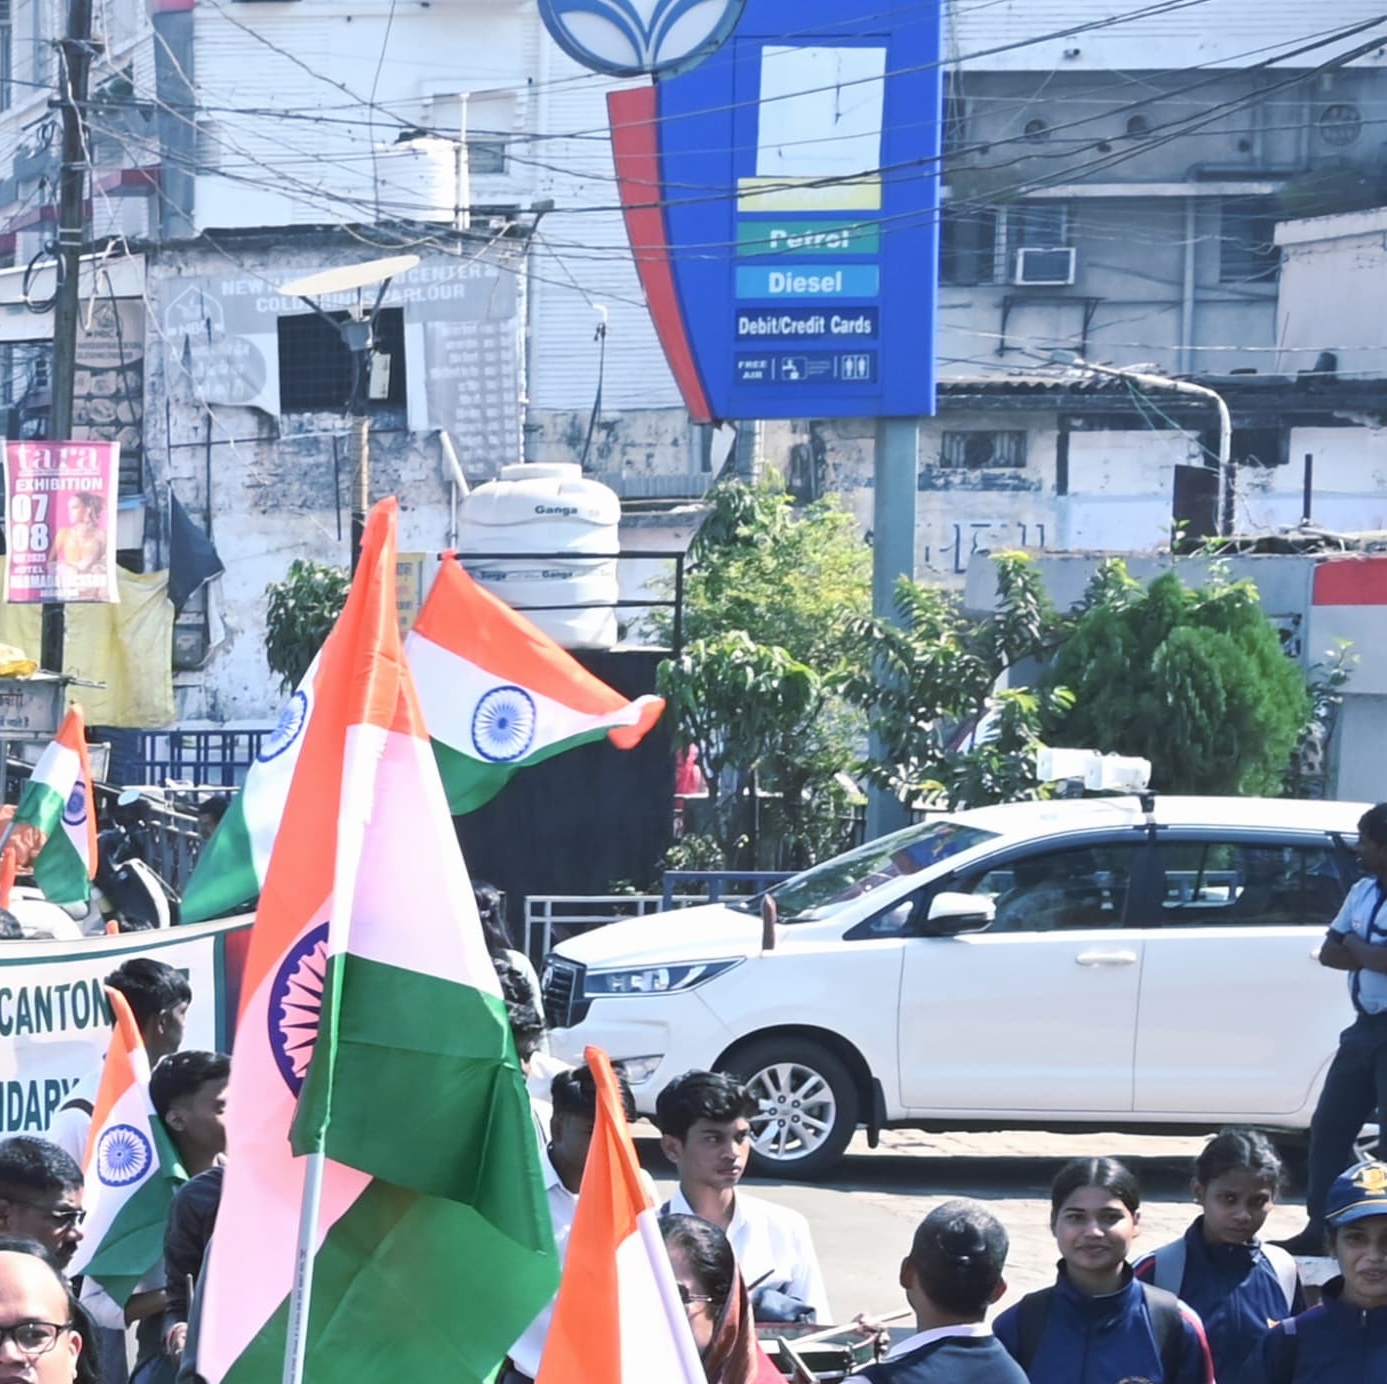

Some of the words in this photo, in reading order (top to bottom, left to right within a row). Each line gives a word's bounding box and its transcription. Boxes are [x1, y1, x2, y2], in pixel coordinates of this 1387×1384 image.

[770, 229, 849, 249] Petrol
[768, 271, 843, 293] Diesel
[738, 317, 826, 335] Debit/Credit
[830, 315, 872, 334] Cards
[16, 444, 99, 470] tara
[15, 477, 103, 491] EXHIBITION
[12, 494, 48, 523] 07
[534, 505, 578, 516] Ganga
[12, 523, 49, 552] 08
[542, 570, 573, 579] Ganga
